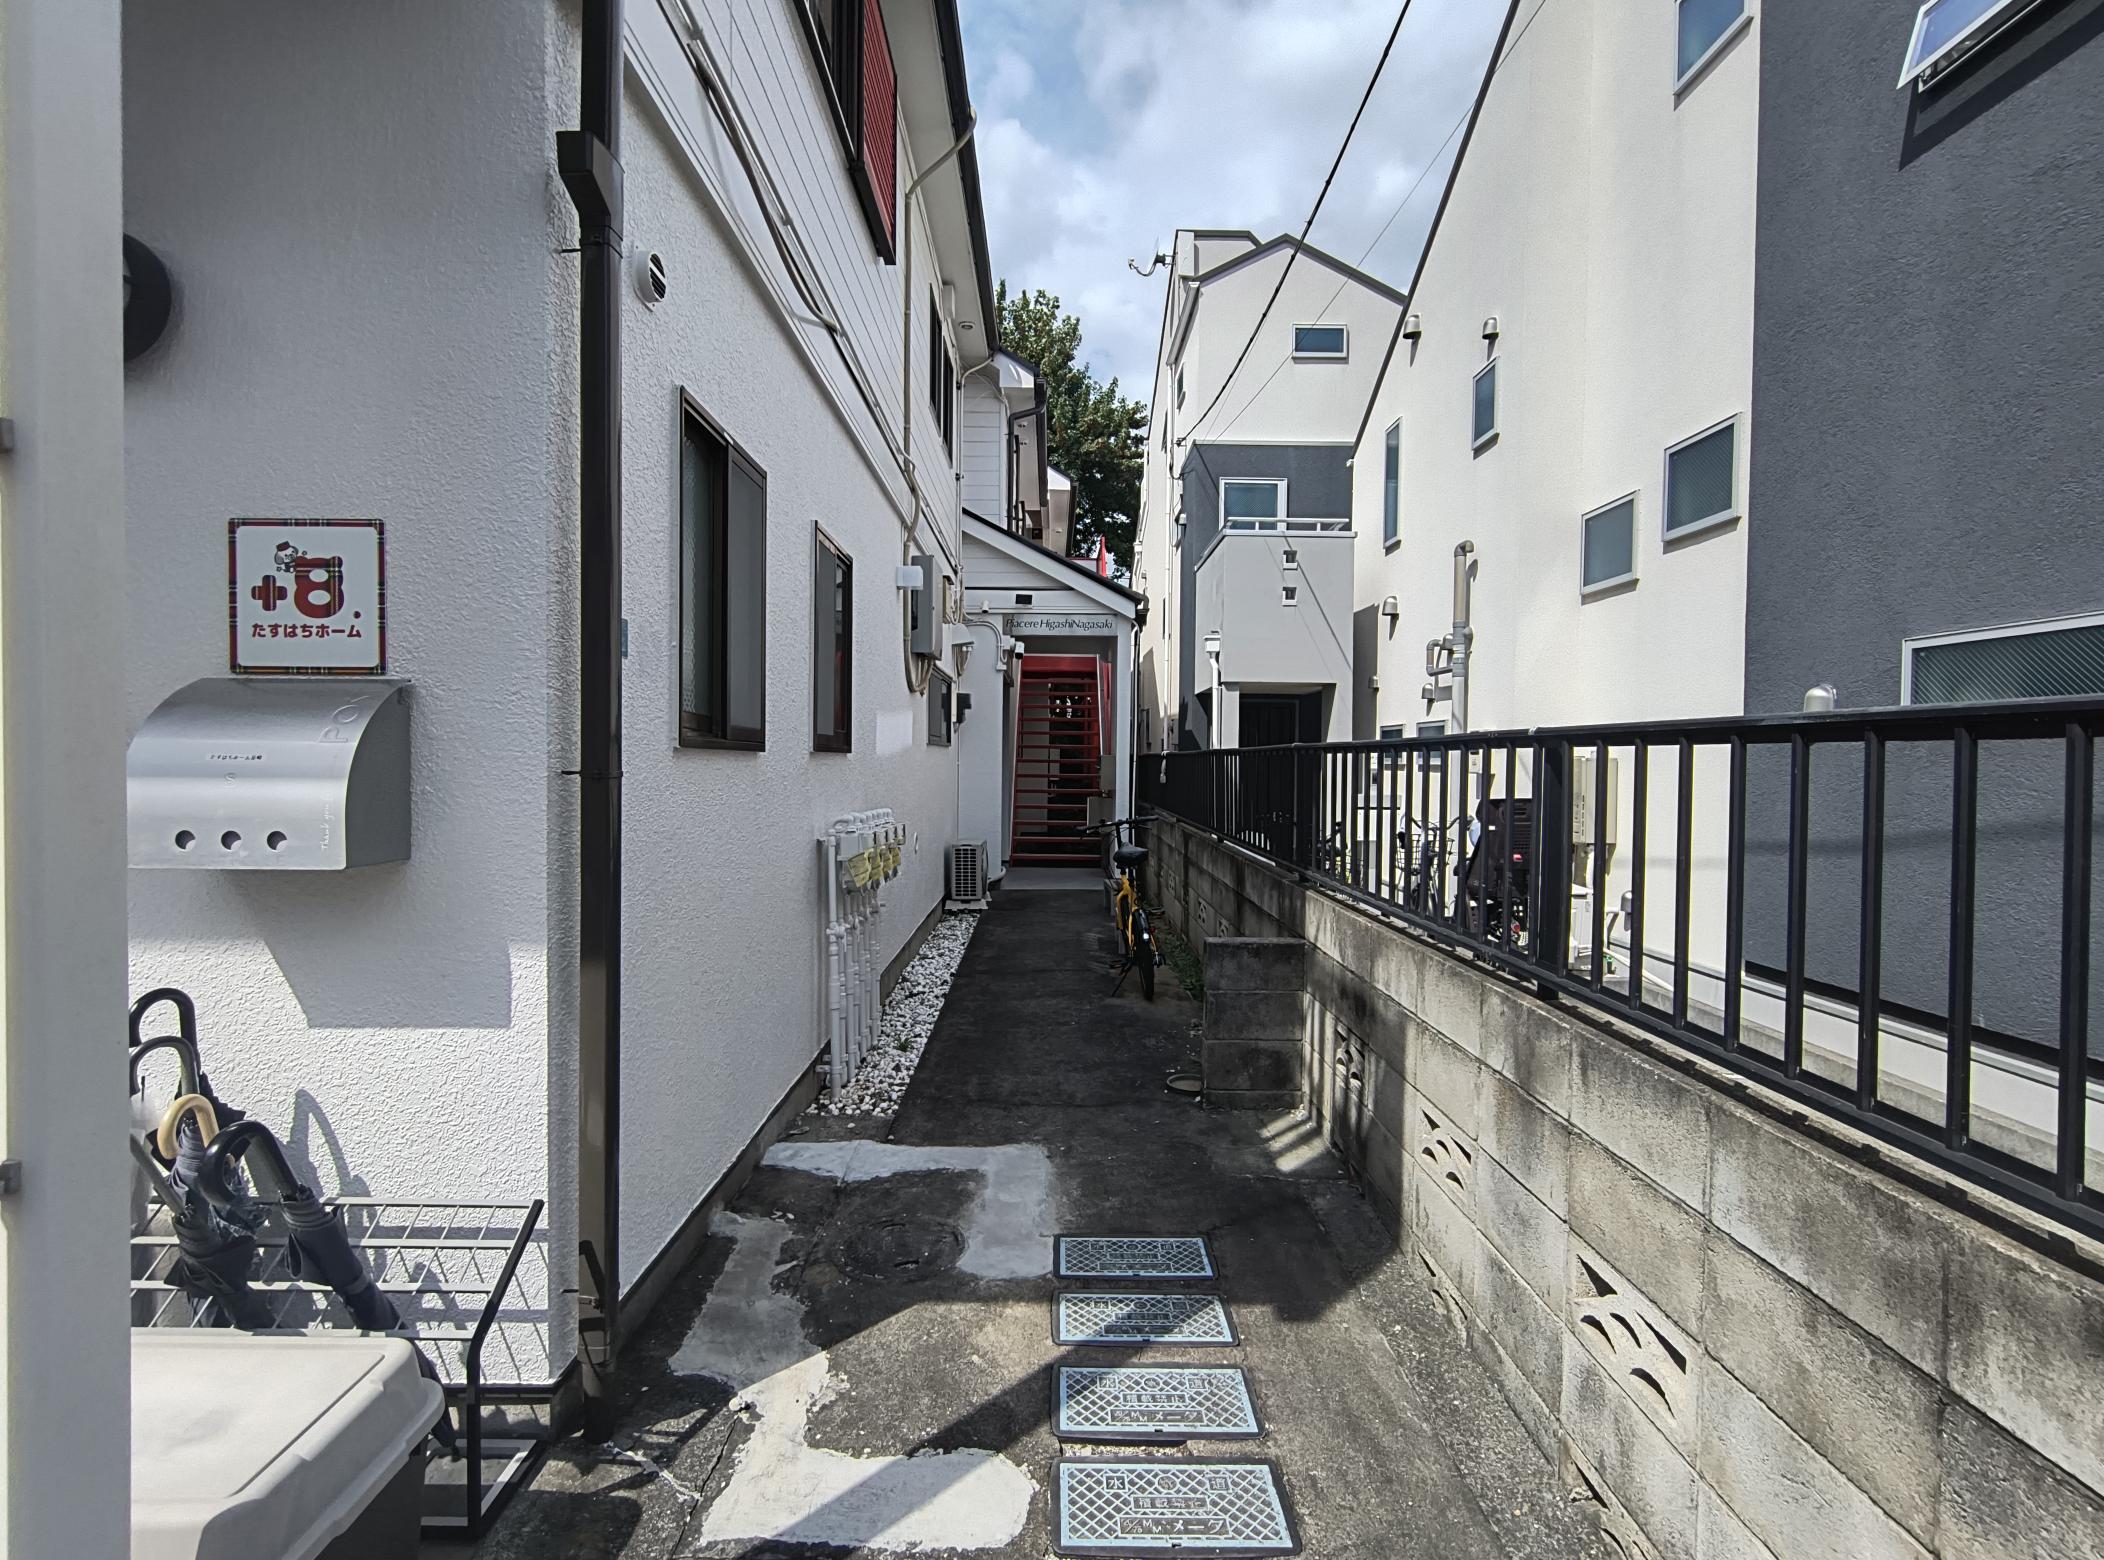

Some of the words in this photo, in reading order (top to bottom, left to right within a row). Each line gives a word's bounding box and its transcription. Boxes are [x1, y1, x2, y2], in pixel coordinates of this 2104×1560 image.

[1005, 618, 1039, 629] Piacere
[251, 623, 362, 638] たすはちホーム
[1108, 1477, 1124, 1489] 水
